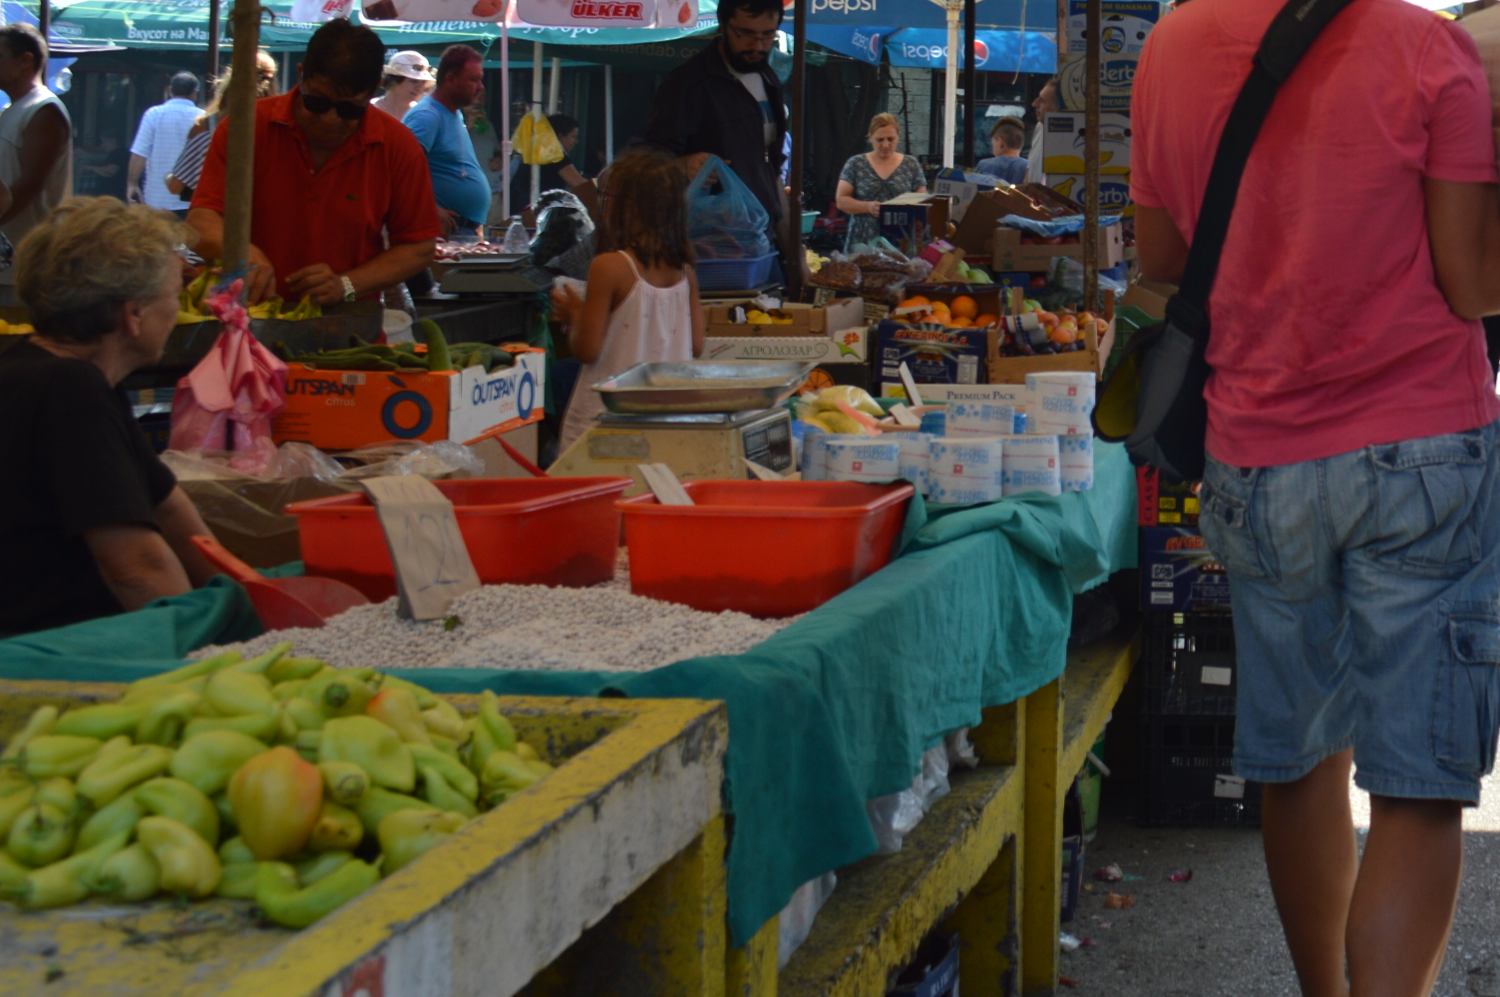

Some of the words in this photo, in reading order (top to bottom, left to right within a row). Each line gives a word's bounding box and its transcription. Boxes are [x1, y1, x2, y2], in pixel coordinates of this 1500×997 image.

[1115, 3, 1153, 11] BANANAS
[127, 27, 169, 40] Вкусот
[172, 29, 185, 39] на
[1100, 63, 1135, 81] derb
[742, 345, 813, 356] АГРОЛОЗАР
[285, 379, 356, 396] UTSPAN
[326, 396, 356, 406] citrus
[992, 390, 1016, 400] PACK
[1165, 536, 1206, 553] AVGE
